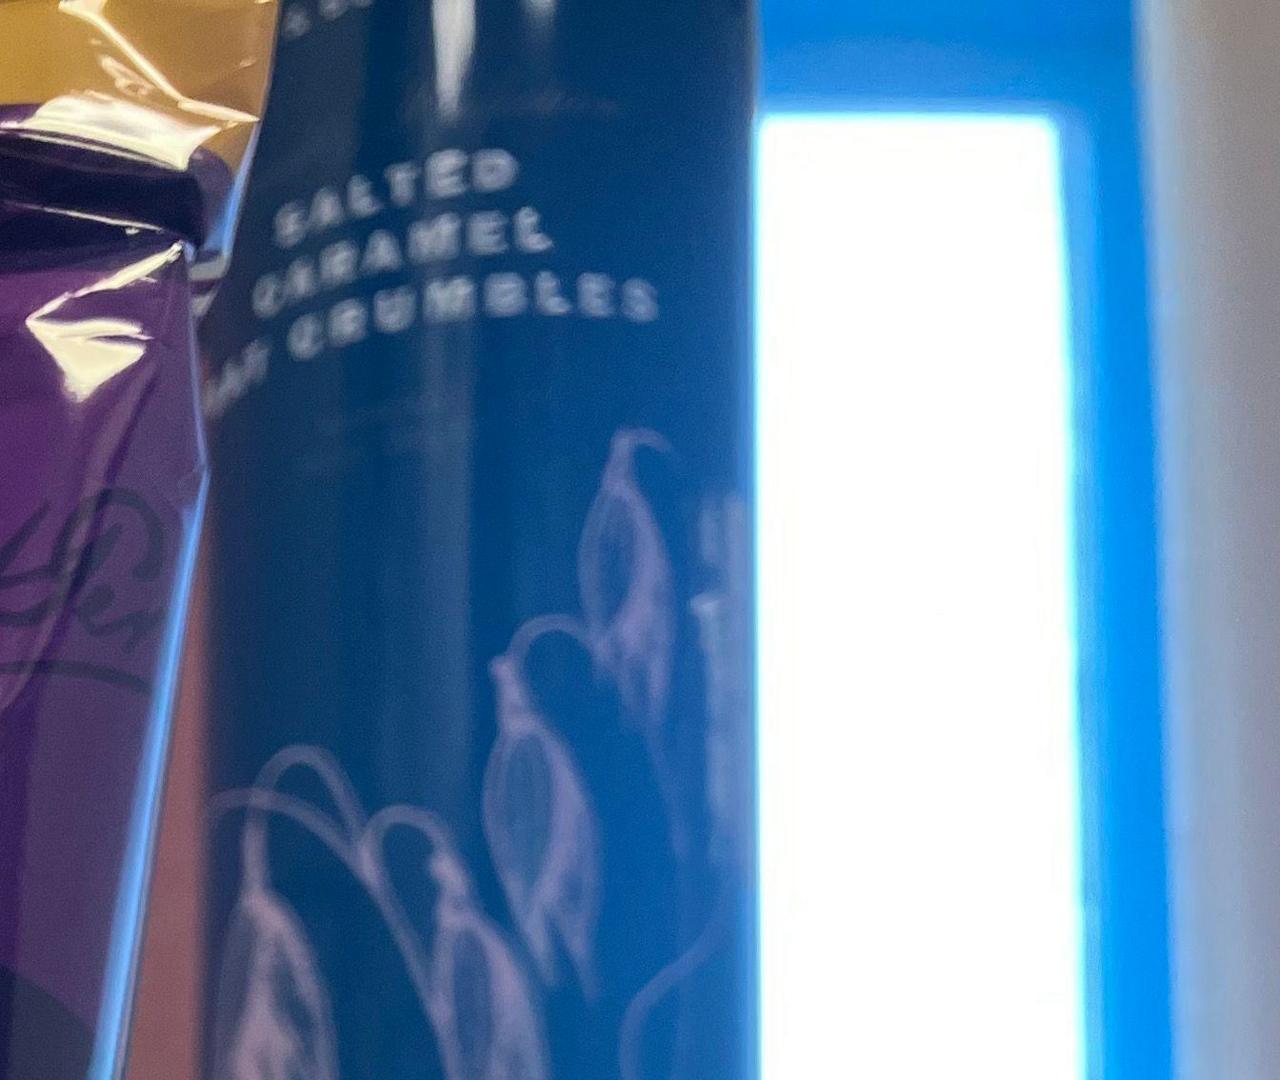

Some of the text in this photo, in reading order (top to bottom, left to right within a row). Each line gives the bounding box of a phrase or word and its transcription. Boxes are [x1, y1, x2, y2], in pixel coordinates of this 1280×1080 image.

[272, 148, 520, 249] SALTED
[252, 206, 555, 319] CARAMEL
[287, 271, 659, 362] CRUMBLES
